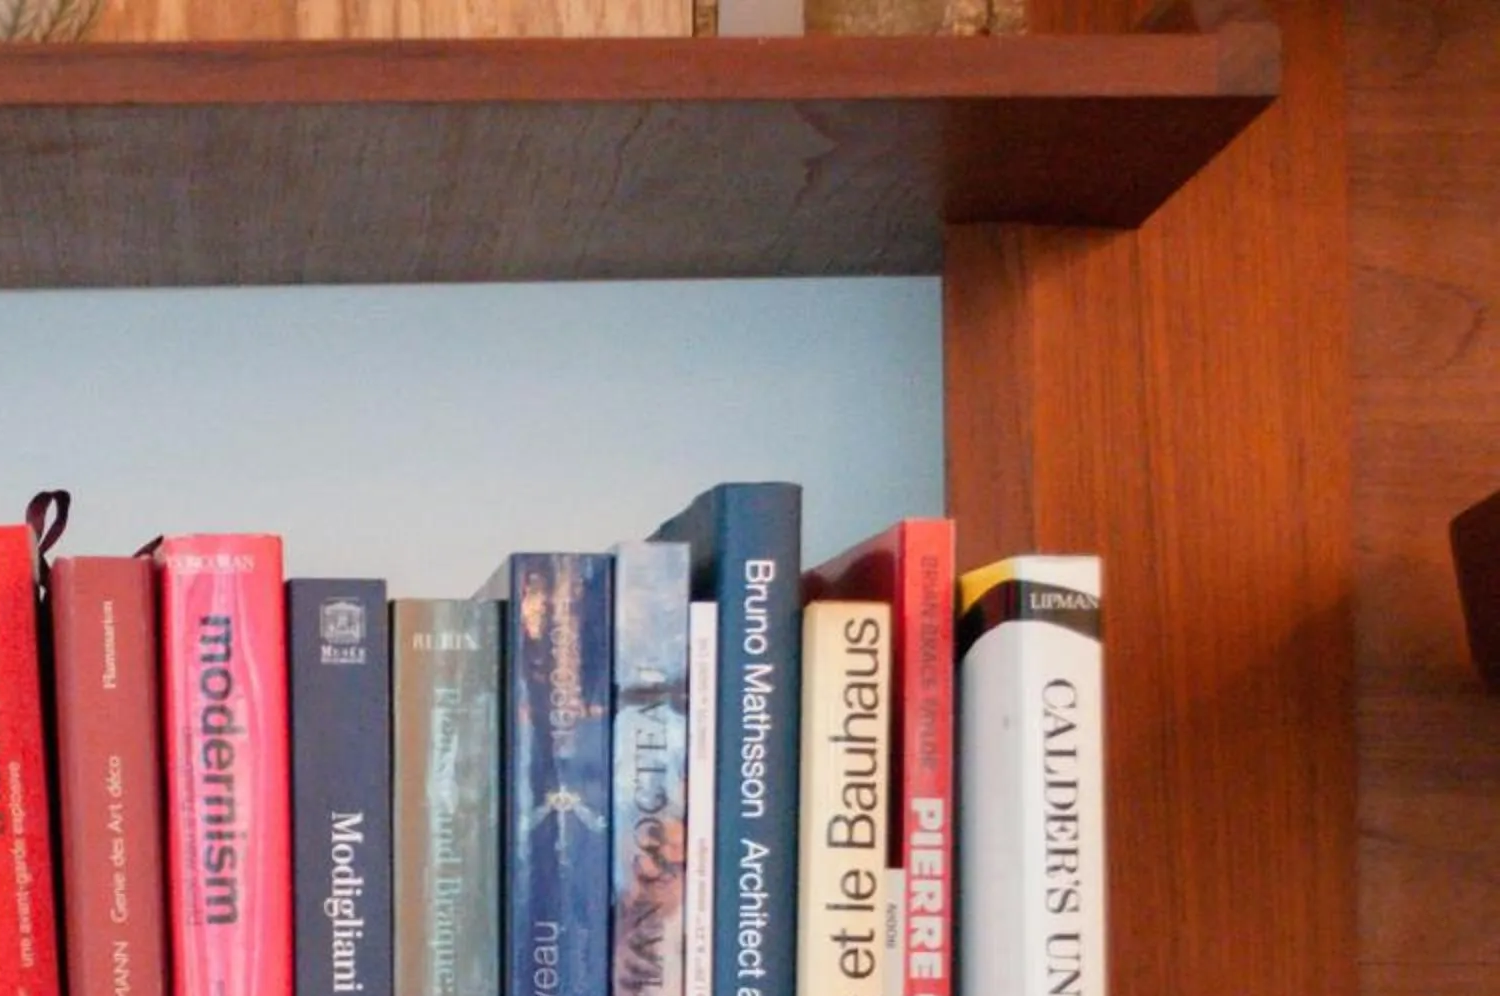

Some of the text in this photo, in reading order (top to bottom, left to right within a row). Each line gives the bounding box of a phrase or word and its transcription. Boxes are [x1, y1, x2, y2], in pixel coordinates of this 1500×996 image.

[101, 600, 117, 690] Flammarion
[743, 559, 775, 655] Bruno
[1029, 591, 1100, 610] LIPMAN
[105, 755, 122, 798] déco
[199, 615, 247, 925] modernism
[740, 665, 774, 819] Mathsson
[826, 616, 881, 850] Bauhaus
[7, 761, 28, 836] explosive
[106, 802, 123, 833] Art
[1040, 677, 1081, 915] CALDER'S
[12, 838, 34, 933] avant-garde
[324, 811, 365, 992] Modigliani
[737, 838, 770, 979] Architect
[825, 868, 877, 912] le
[910, 797, 944, 979] PIERRE
[17, 938, 34, 967] une
[831, 928, 875, 979] et
